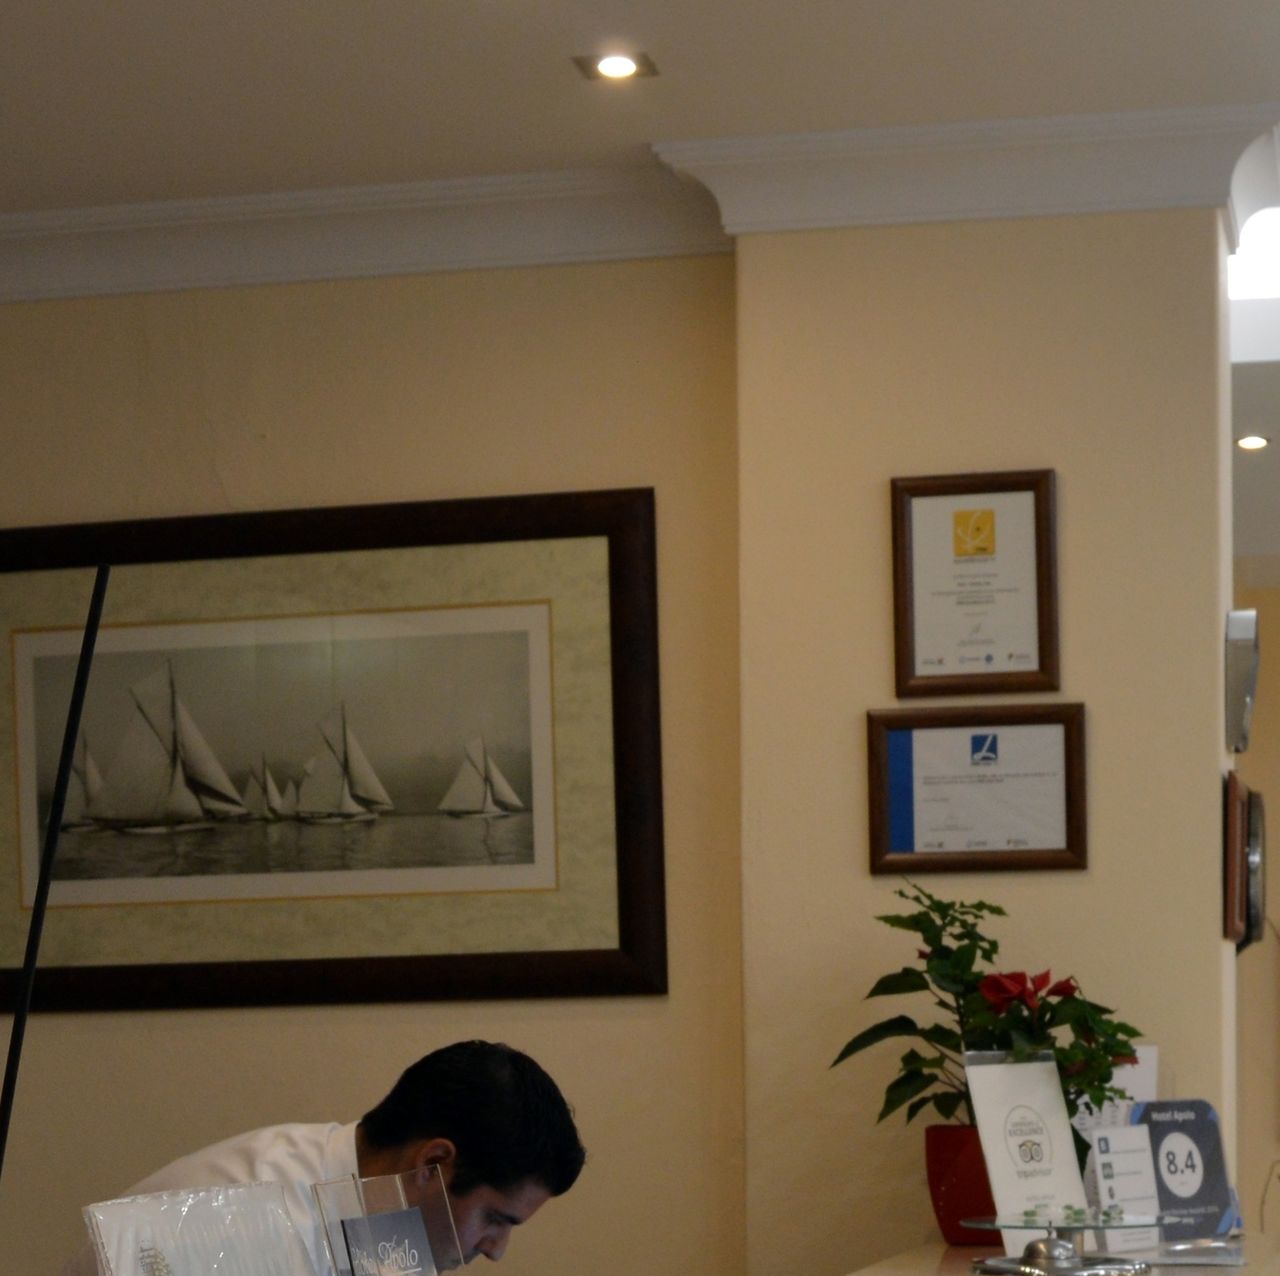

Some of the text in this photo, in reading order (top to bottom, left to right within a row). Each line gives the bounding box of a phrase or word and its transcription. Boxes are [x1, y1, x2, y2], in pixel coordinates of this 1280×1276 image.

[1151, 1110, 1196, 1123] Hotel Apolo
[1166, 1150, 1196, 1175] 8.4
